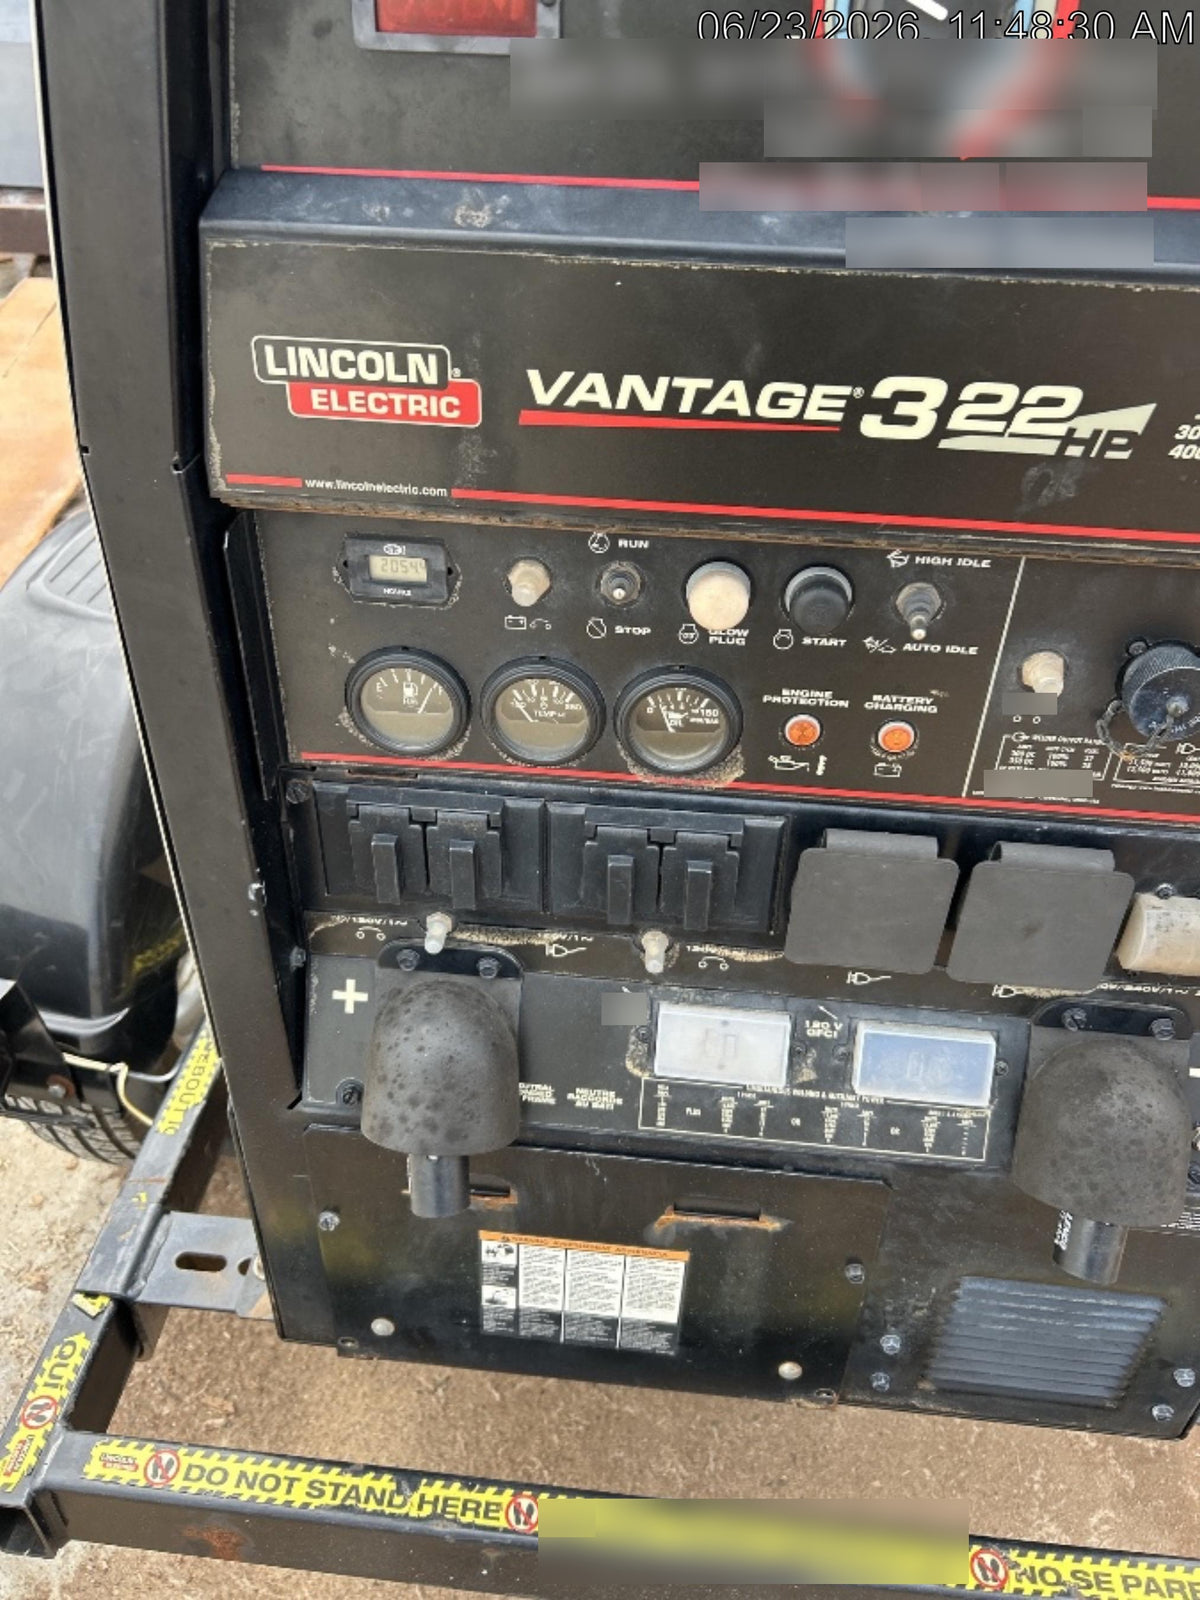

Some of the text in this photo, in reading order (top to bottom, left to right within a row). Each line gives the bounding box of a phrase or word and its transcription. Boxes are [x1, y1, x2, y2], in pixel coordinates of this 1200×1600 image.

[310, 388, 461, 419] ELECTRIC
[860, 375, 1083, 440] 322
[305, 479, 447, 497] www.lincolnelectric.com
[618, 538, 649, 549] RUN
[915, 556, 992, 568] HIGH IDLE
[614, 625, 651, 636] STOP
[708, 636, 746, 646] PLUG
[801, 636, 848, 647] START
[903, 642, 979, 655] AUTO IDLE
[781, 687, 833, 699] ENGINE
[762, 695, 849, 708] PROTECTION
[872, 694, 933, 705] BATTERY
[864, 701, 938, 713] CHARGING
[804, 1019, 843, 1031] 120 V
[806, 1028, 838, 1039] GFCI
[183, 1463, 503, 1522] DO NOT STAND HERE
[1015, 1565, 1063, 1587] NO
[1069, 1569, 1115, 1592] SE
